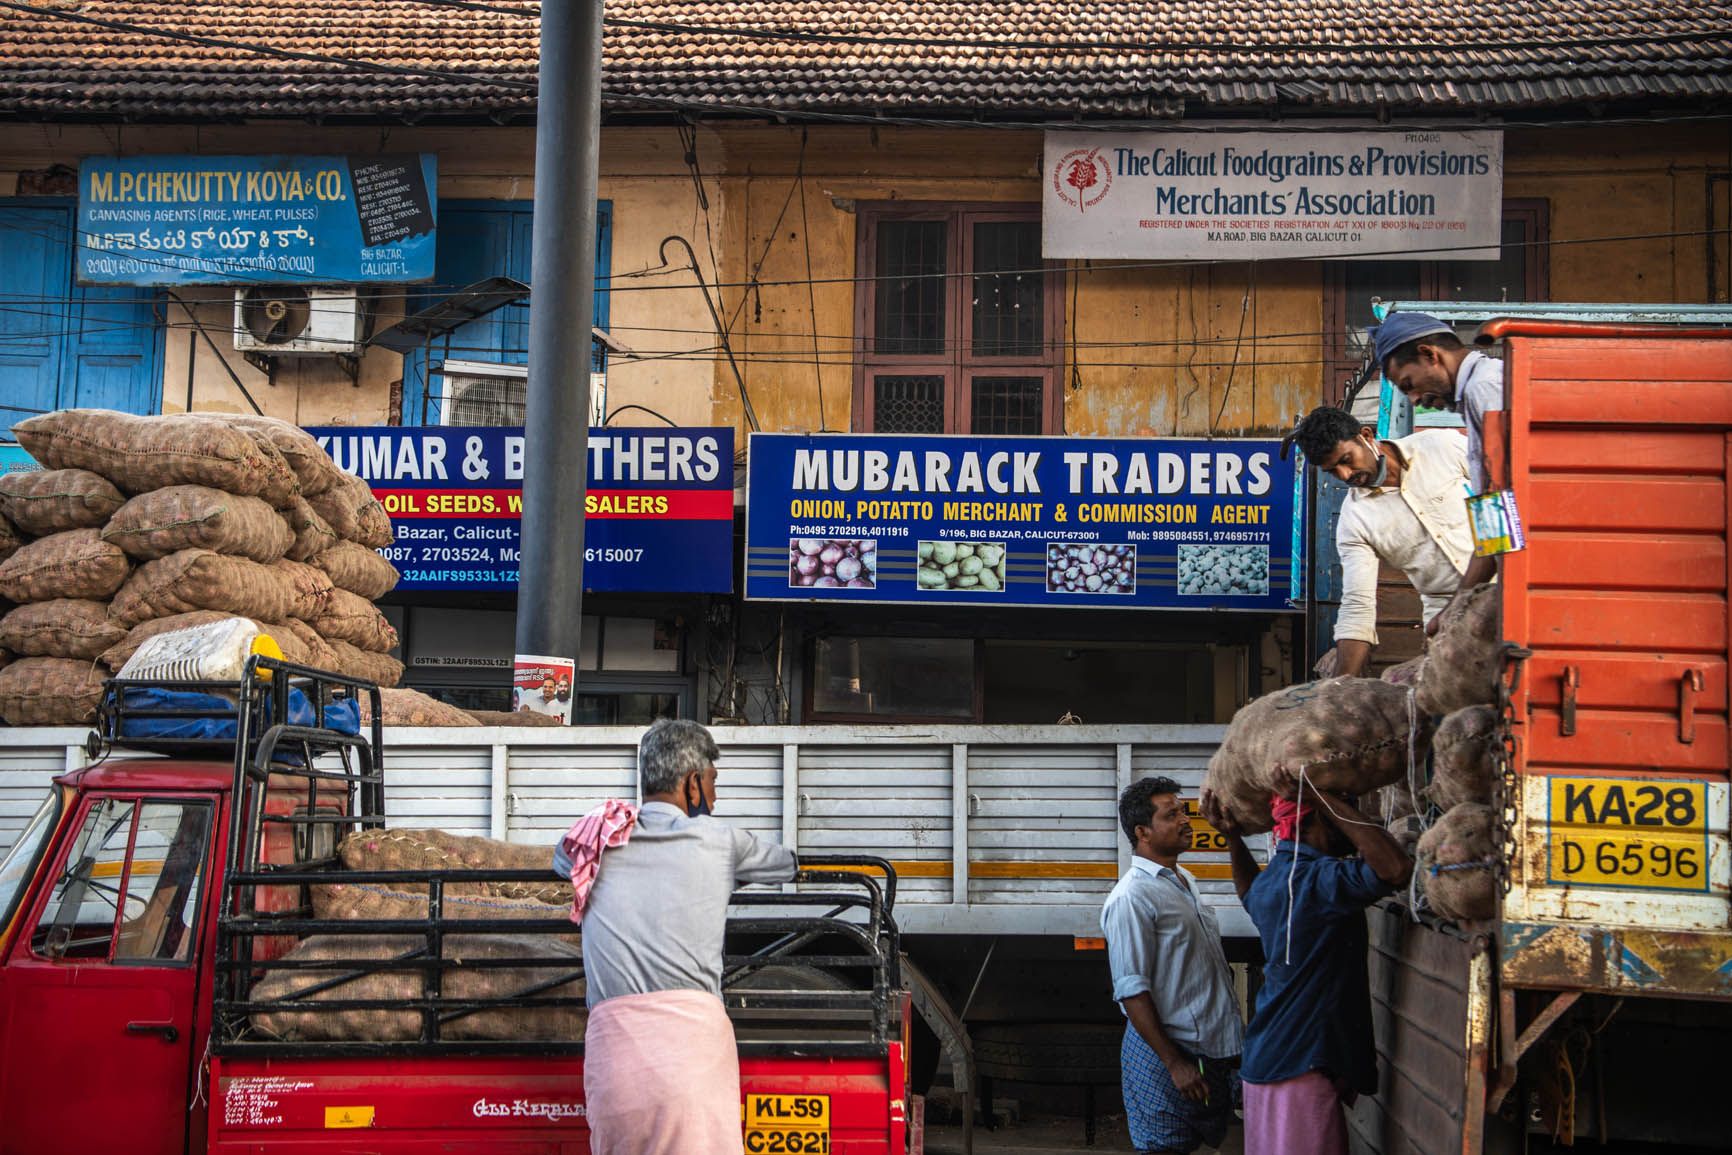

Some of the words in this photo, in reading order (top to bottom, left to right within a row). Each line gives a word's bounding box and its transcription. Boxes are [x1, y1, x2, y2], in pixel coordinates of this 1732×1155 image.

[1113, 148, 1150, 176] The
[1151, 148, 1218, 176] Calicut
[1222, 147, 1345, 183] Foodgrains
[1348, 154, 1366, 176] &
[1366, 147, 1489, 176] Provisions
[247, 171, 305, 201] KOYA
[305, 178, 314, 195] &
[316, 170, 346, 201] CO.
[1295, 186, 1436, 216] Association
[89, 209, 151, 221] CANVASING
[153, 209, 197, 221] AGENTS
[1139, 220, 1182, 229] REGISTERED
[1185, 220, 1209, 229] UNDER
[1212, 220, 1227, 229] THE
[1230, 220, 1270, 229] SOCIETIES
[1274, 220, 1330, 229] REGISTRATION
[1333, 220, 1350, 229] ACT
[1368, 220, 1378, 229] OF
[1250, 231, 1266, 241] BIG
[1270, 231, 1303, 242] BAZAR
[1305, 231, 1350, 242] CALICUT
[462, 435, 490, 480] &
[504, 436, 719, 481] BTHERS
[791, 449, 1041, 494] MUBARACK
[1064, 452, 1271, 495] TRADERS
[384, 496, 420, 513] OIL
[507, 496, 669, 513] WSALERS
[790, 500, 852, 522] ONION,
[857, 501, 933, 520] POTATTO
[943, 502, 1043, 521] MERCHANT
[1054, 503, 1068, 522] &
[1078, 503, 1197, 524] COMMISSION
[1210, 505, 1270, 524] AGENT
[397, 525, 448, 541] Bazar,
[940, 529, 968, 540] 9/196,
[970, 530, 987, 539] BIG
[1025, 530, 1100, 540] CALICUT-673001
[1127, 530, 1150, 541] Mob:
[421, 548, 494, 562] 2703524,
[415, 657, 441, 665] GSTIN:
[1562, 841, 1586, 874] D
[1596, 842, 1699, 878] 6596
